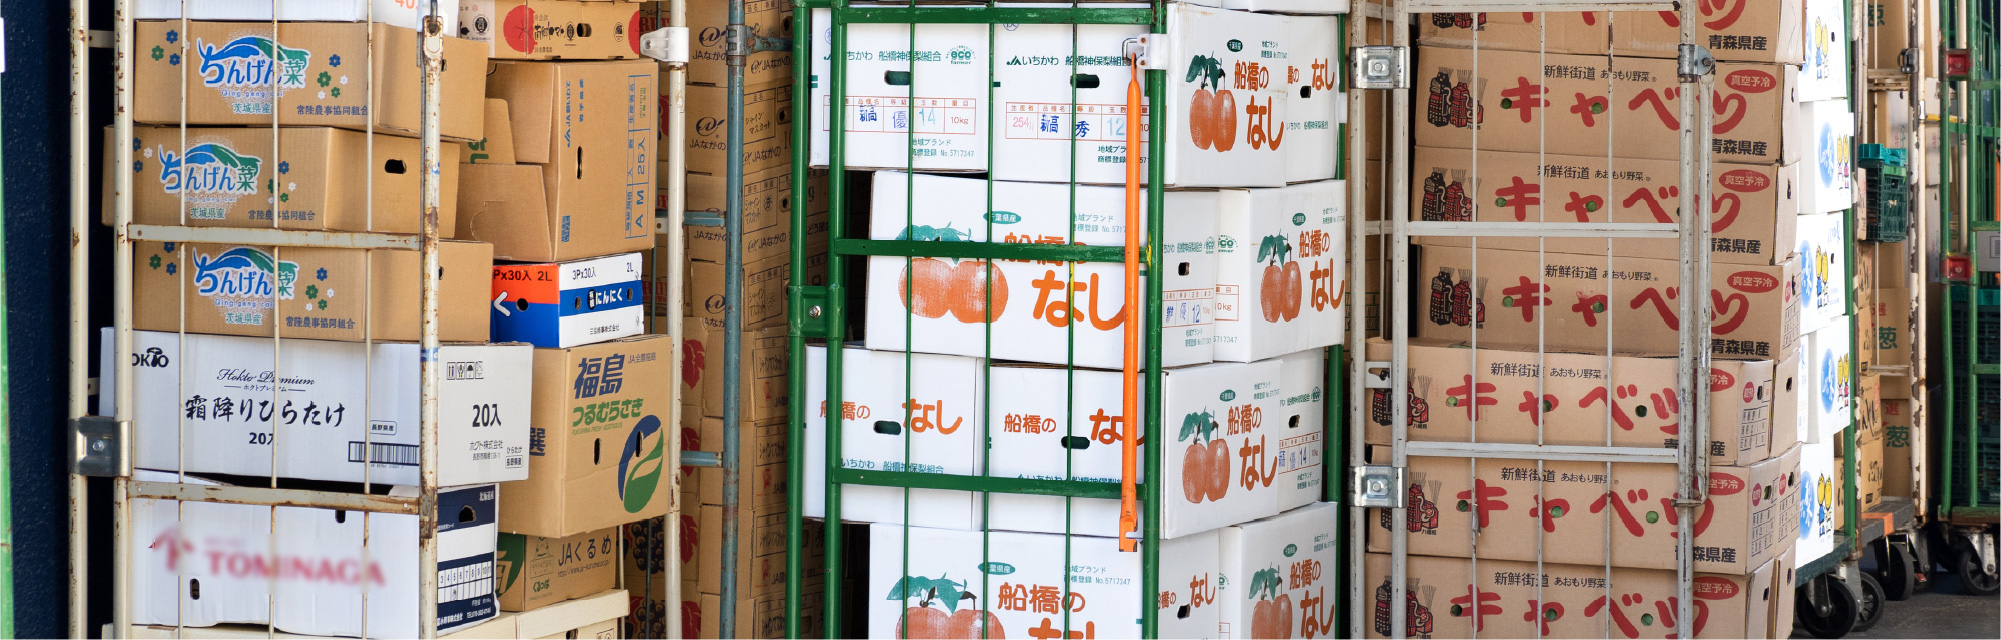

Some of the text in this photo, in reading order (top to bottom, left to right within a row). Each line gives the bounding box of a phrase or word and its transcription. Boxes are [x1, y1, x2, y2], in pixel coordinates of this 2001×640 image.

[1708, 34, 1768, 51] 青森県産
[198, 42, 305, 86] ちんげん菜
[692, 50, 727, 61] JAながの
[762, 55, 791, 71] JAながの
[878, 50, 941, 62] 船橋神保梨組合
[1233, 60, 1270, 92] 船橋の
[1287, 57, 1335, 91] 橋の なし
[1543, 64, 1651, 83] 新鮮街道 あおもり野菜
[1730, 74, 1772, 88] 真空予冷
[233, 103, 272, 114] 茨城県産
[296, 105, 368, 116] 常陸農事協同組合
[1500, 76, 1747, 135] キャベツ
[918, 107, 937, 127] 14
[950, 116, 969, 126] 10kg
[1245, 94, 1285, 151] なし
[1075, 120, 1090, 138] 秀
[1106, 116, 1125, 136] 12
[689, 138, 727, 151] JAながの
[752, 145, 781, 163] JAながの
[940, 150, 975, 158] No.5717347
[1097, 144, 1127, 154] 地域ブラ
[1712, 138, 1768, 157] 青森県産
[637, 136, 646, 175] 25入
[160, 152, 255, 192] ちんげん菜
[1537, 164, 1645, 182] 新鮮街道 あおもり野菜
[1724, 174, 1765, 187] 真空予冷
[190, 208, 225, 219] 茨城県産
[1495, 176, 1741, 234] キャベツ
[758, 232, 787, 249] JAながの
[1298, 229, 1331, 259] 船橋の
[195, 255, 294, 297] ちんげん菜
[494, 269, 553, 282] Px30入 2L
[572, 262, 634, 280] 3Px30入 2L
[1544, 263, 1653, 282] 新鮮街道 あおもり野菜
[1309, 257, 1345, 312] なし
[1731, 275, 1774, 288] 真空予冷
[215, 299, 233, 307] Qing
[595, 287, 623, 306] にんにく
[1031, 269, 1126, 332] なし
[1502, 275, 1750, 336] キャベツ
[225, 313, 263, 325] 茨城県産
[286, 316, 356, 329] 常陸農事協同組合
[1711, 338, 1770, 357] 青森県産
[132, 347, 169, 368] OKTO
[217, 368, 257, 383] Hokto
[573, 353, 626, 400] 福島
[1490, 362, 1602, 380] 新鮮街道 あおもり野菜
[243, 385, 288, 393] ホクトプレミム
[185, 395, 345, 427] 霜降りひらたけ
[572, 398, 644, 428] つるむらさき
[1445, 373, 1697, 436] キャベツ
[472, 403, 502, 428] 20入
[901, 398, 963, 435] なし
[1003, 412, 1057, 435] 船橋の
[1226, 403, 1262, 437] 船橋の
[371, 424, 395, 432] 長野県産
[1886, 424, 1911, 449] 葱
[470, 440, 504, 452] ホクト株式会社
[1238, 433, 1278, 491] なし
[1500, 466, 1556, 484] 新鮮街道
[1708, 478, 1739, 490] 空予冷
[1455, 478, 1715, 539] キャベツ
[558, 534, 612, 567] JAくるめ
[1675, 545, 1737, 564] 森県産
[989, 564, 1012, 574] 葉県産
[1065, 564, 1107, 574] 域ブランド
[1289, 558, 1322, 590] 船橋の
[1064, 575, 1131, 586] 標登録 No.5717347
[1494, 571, 1607, 589] 新鮮街道 あおもり野菜
[997, 581, 1086, 615] 船橋の
[1189, 571, 1216, 609] なし
[1300, 585, 1336, 640] なし
[1450, 583, 1710, 640] キャベツ
